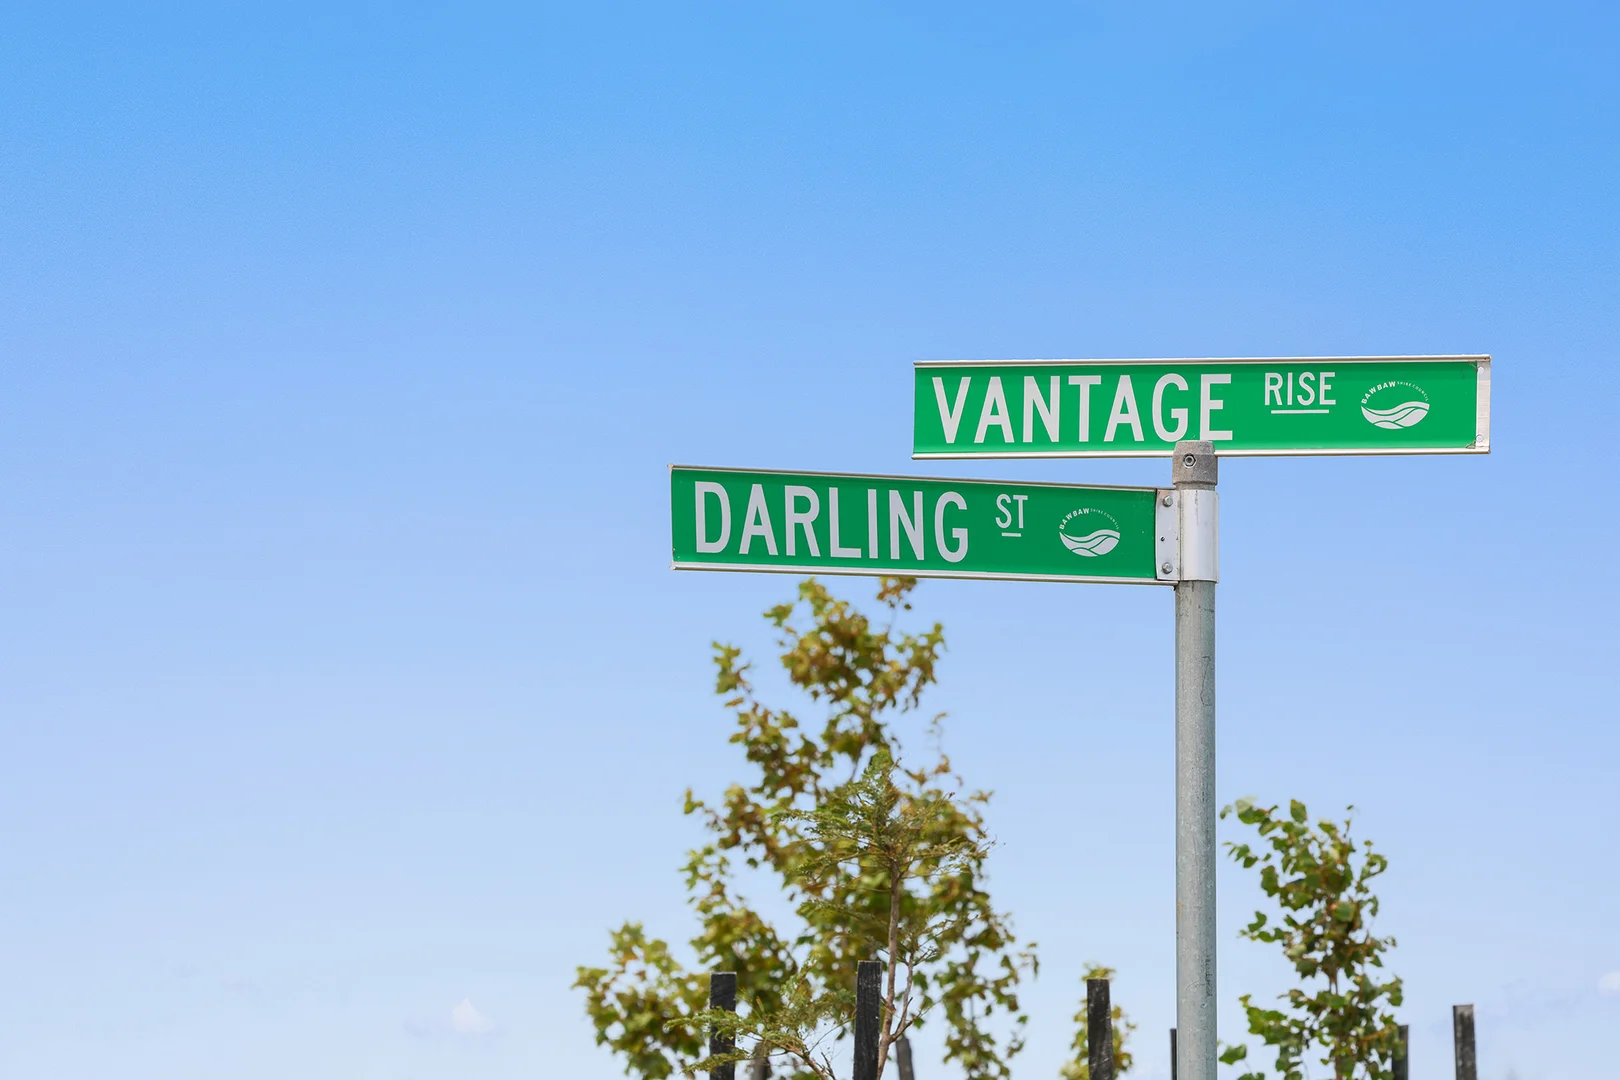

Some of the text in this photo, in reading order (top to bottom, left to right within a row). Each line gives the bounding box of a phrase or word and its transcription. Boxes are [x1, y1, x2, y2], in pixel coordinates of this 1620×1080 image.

[931, 371, 1337, 444] VANTAGE RISE
[694, 480, 1029, 563] DARLING ST
